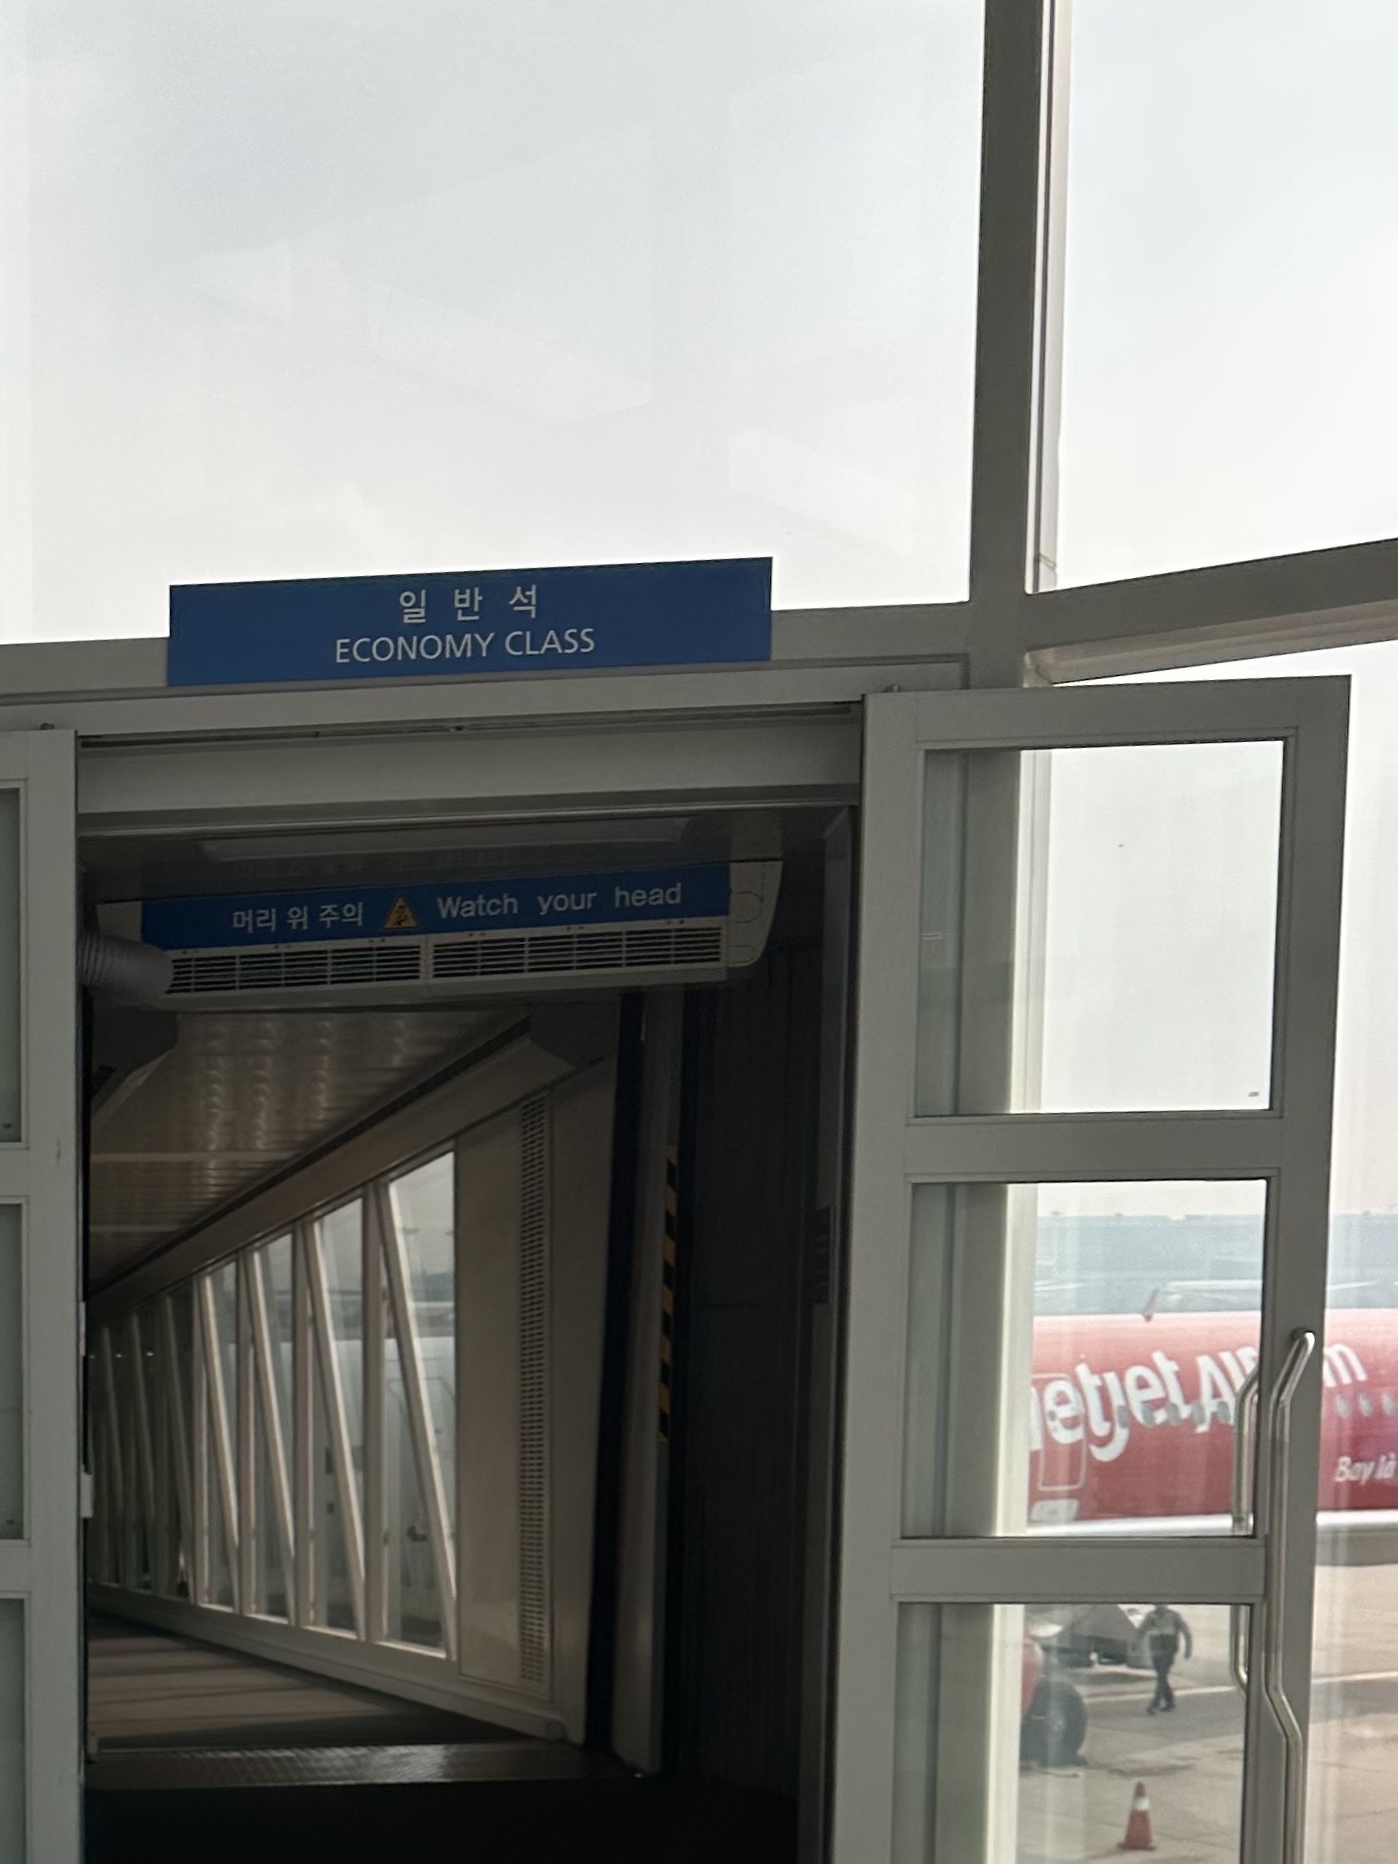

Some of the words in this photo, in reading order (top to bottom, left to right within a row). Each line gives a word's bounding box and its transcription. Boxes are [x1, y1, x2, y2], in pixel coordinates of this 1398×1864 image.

[334, 632, 495, 664] ECONOMY
[504, 627, 596, 657] CLASS
[232, 909, 278, 934] 머리
[318, 901, 365, 929] 주의
[437, 893, 520, 919] Watch
[536, 891, 598, 916] your
[614, 882, 682, 908] head
